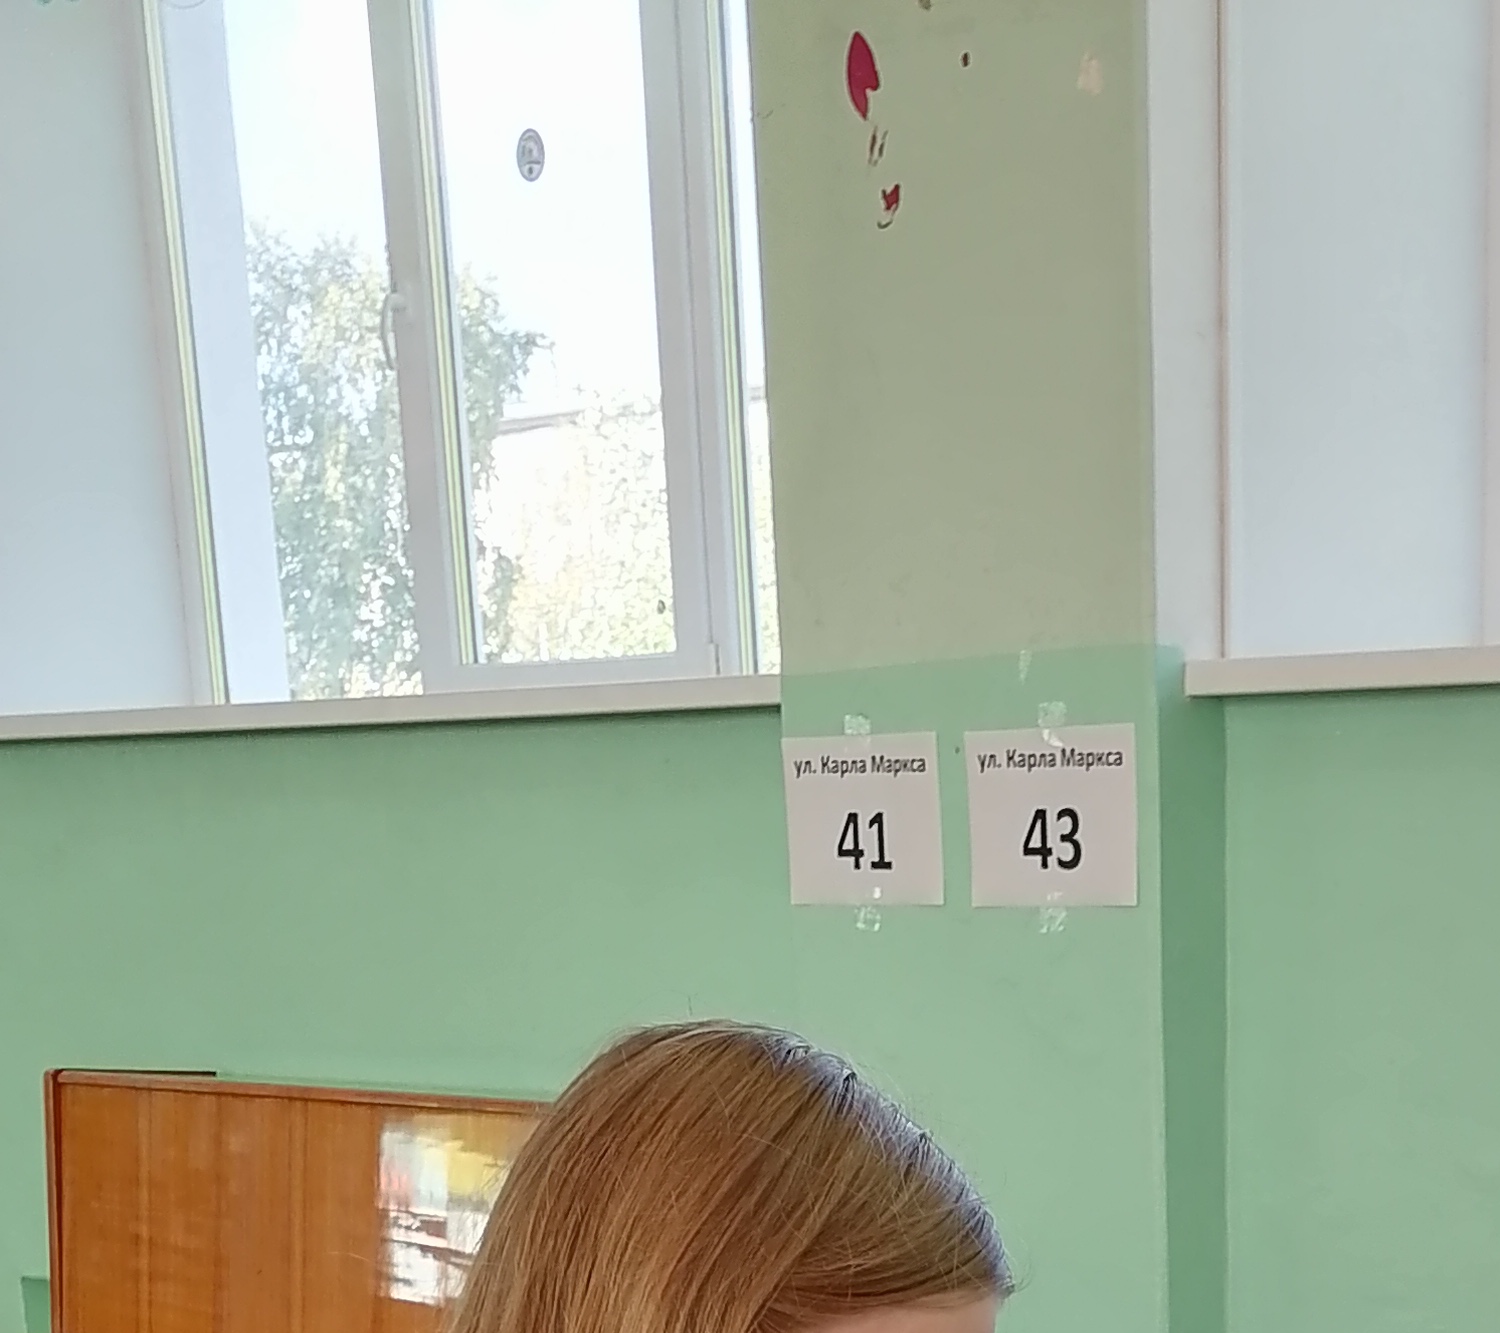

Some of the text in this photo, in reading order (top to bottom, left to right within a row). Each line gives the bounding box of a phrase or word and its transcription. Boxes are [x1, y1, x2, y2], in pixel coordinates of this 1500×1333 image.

[793, 754, 926, 779] ул. Карла Маркса
[977, 747, 1124, 774] ул. Карла Маркса
[837, 811, 893, 871] 41
[1022, 807, 1082, 871] 43
